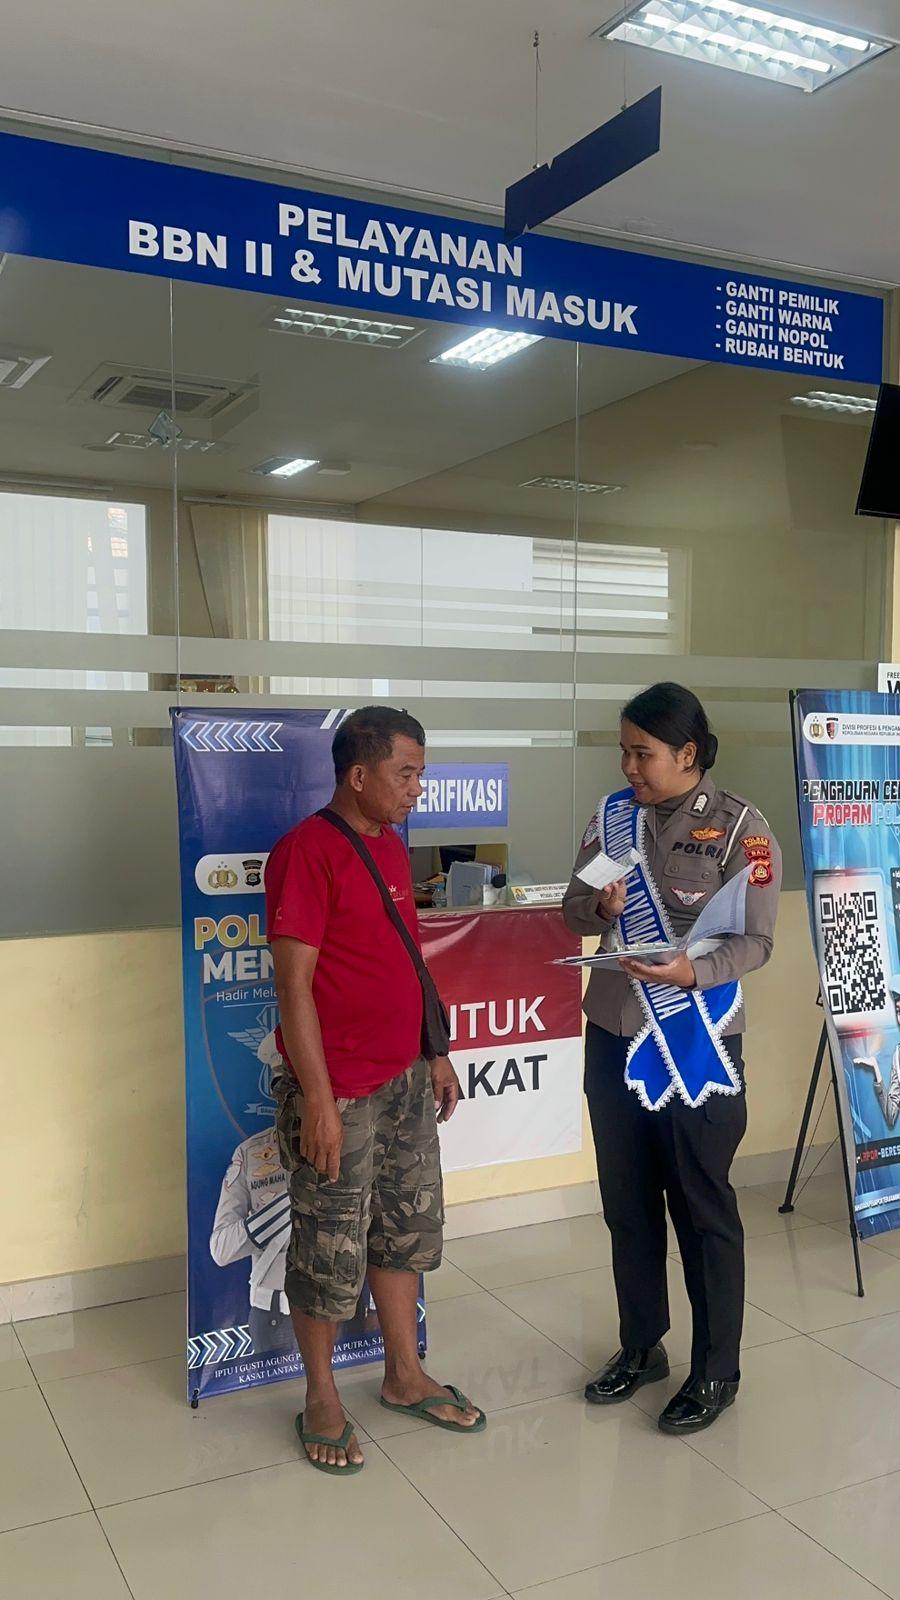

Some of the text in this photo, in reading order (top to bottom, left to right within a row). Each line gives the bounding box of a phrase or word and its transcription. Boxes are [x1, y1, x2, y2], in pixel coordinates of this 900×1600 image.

[279, 203, 522, 277] PELAYANAN
[129, 220, 638, 335] BBN II & MUTASI MASUK
[725, 281, 774, 303] GANTI
[778, 290, 839, 315] PEMILIK
[725, 300, 774, 322] GANTI
[778, 308, 832, 332] WARNA
[725, 319, 774, 340] GANTI
[778, 327, 829, 349] NOPOL
[725, 338, 779, 360] RUBAH
[783, 346, 844, 370] BENTUK
[411, 779, 503, 813] ERIFIKASI
[803, 779, 900, 801] PENGADUAN CE
[813, 803, 873, 827] PROPAM
[672, 841, 724, 859] POLRI
[194, 914, 269, 950] POL
[203, 949, 275, 984] MEN
[216, 987, 277, 1002] Hadir Mel
[458, 1054, 548, 1100] KAT
[215, 1366, 234, 1378] IPTU
[239, 1360, 264, 1372] GUSTI
[265, 1354, 294, 1367] AGUNG
[239, 1371, 265, 1383] KASAT
[267, 1364, 298, 1377] LANTAS
[331, 1346, 385, 1364] KARANGASEM
